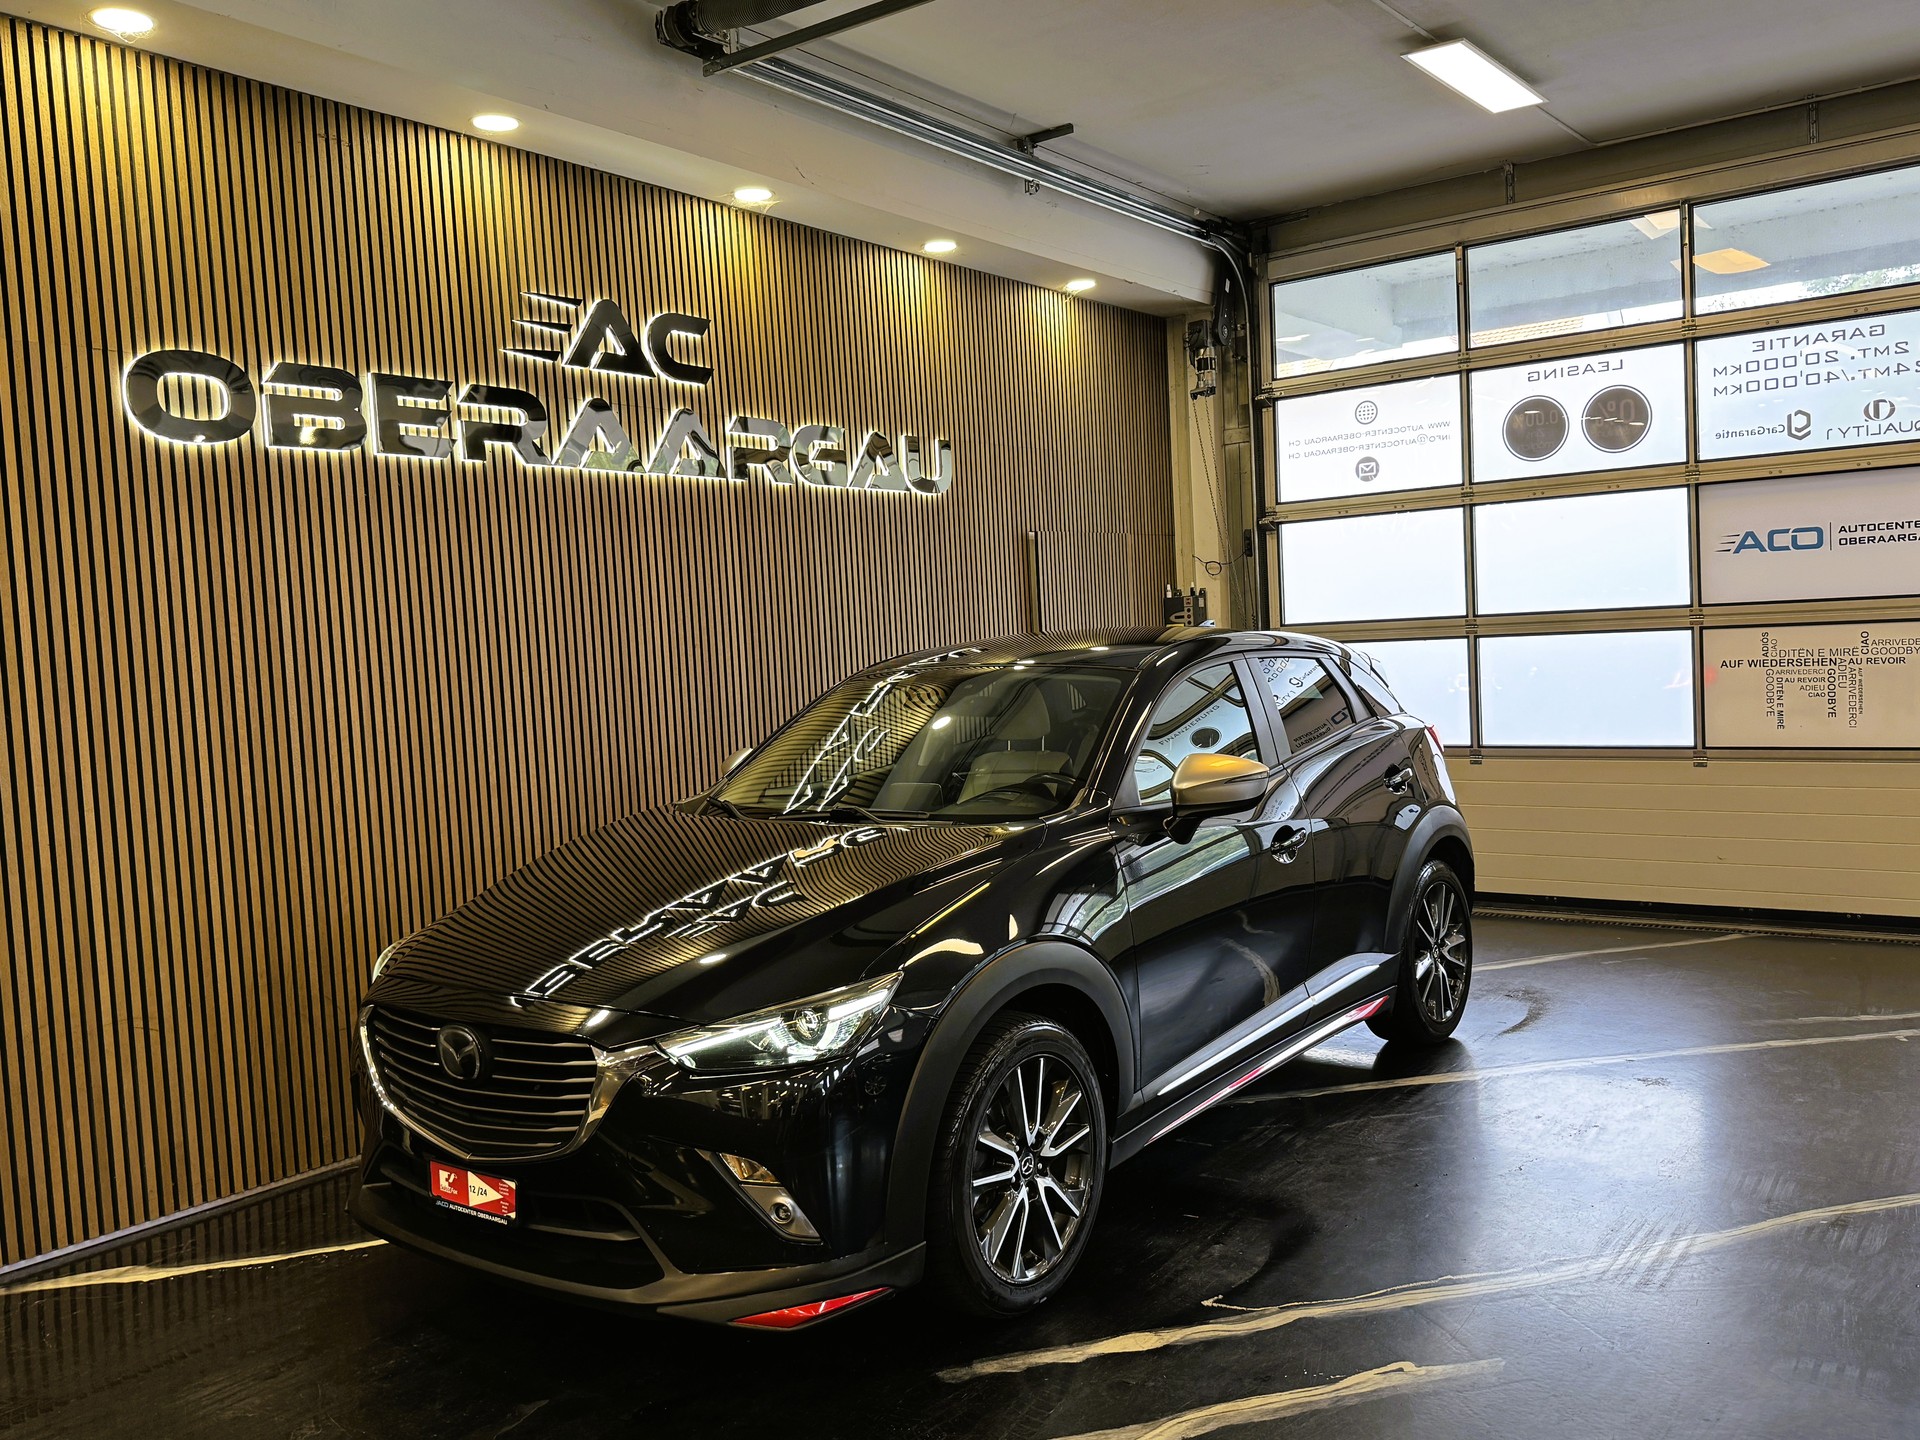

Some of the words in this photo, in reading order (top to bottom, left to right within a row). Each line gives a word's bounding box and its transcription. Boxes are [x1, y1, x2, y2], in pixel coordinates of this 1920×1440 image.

[122, 349, 954, 497] OBERAARGAU
[1838, 520, 1920, 533] AUTOCENTE
[1733, 526, 1824, 554] ACO
[1770, 638, 1778, 657] CIAO
[1860, 630, 1870, 655] CIAO
[1871, 646, 1920, 655] GOODBY
[1817, 648, 1825, 657] E
[1848, 657, 1863, 666] AU
[1866, 656, 1906, 665] REVOIR
[1720, 659, 1744, 669] AUF
[1747, 657, 1838, 668] WIEDERSEHEN
[1775, 668, 1826, 676] ARRIVEDERCI
[1797, 676, 1826, 684] REVOIR
[1838, 657, 1848, 689] ADIEU
[1765, 668, 1775, 717] GOODBYE
[1827, 668, 1837, 718] GOODBYE
[1848, 667, 1857, 729] ARRIVEDERCI
